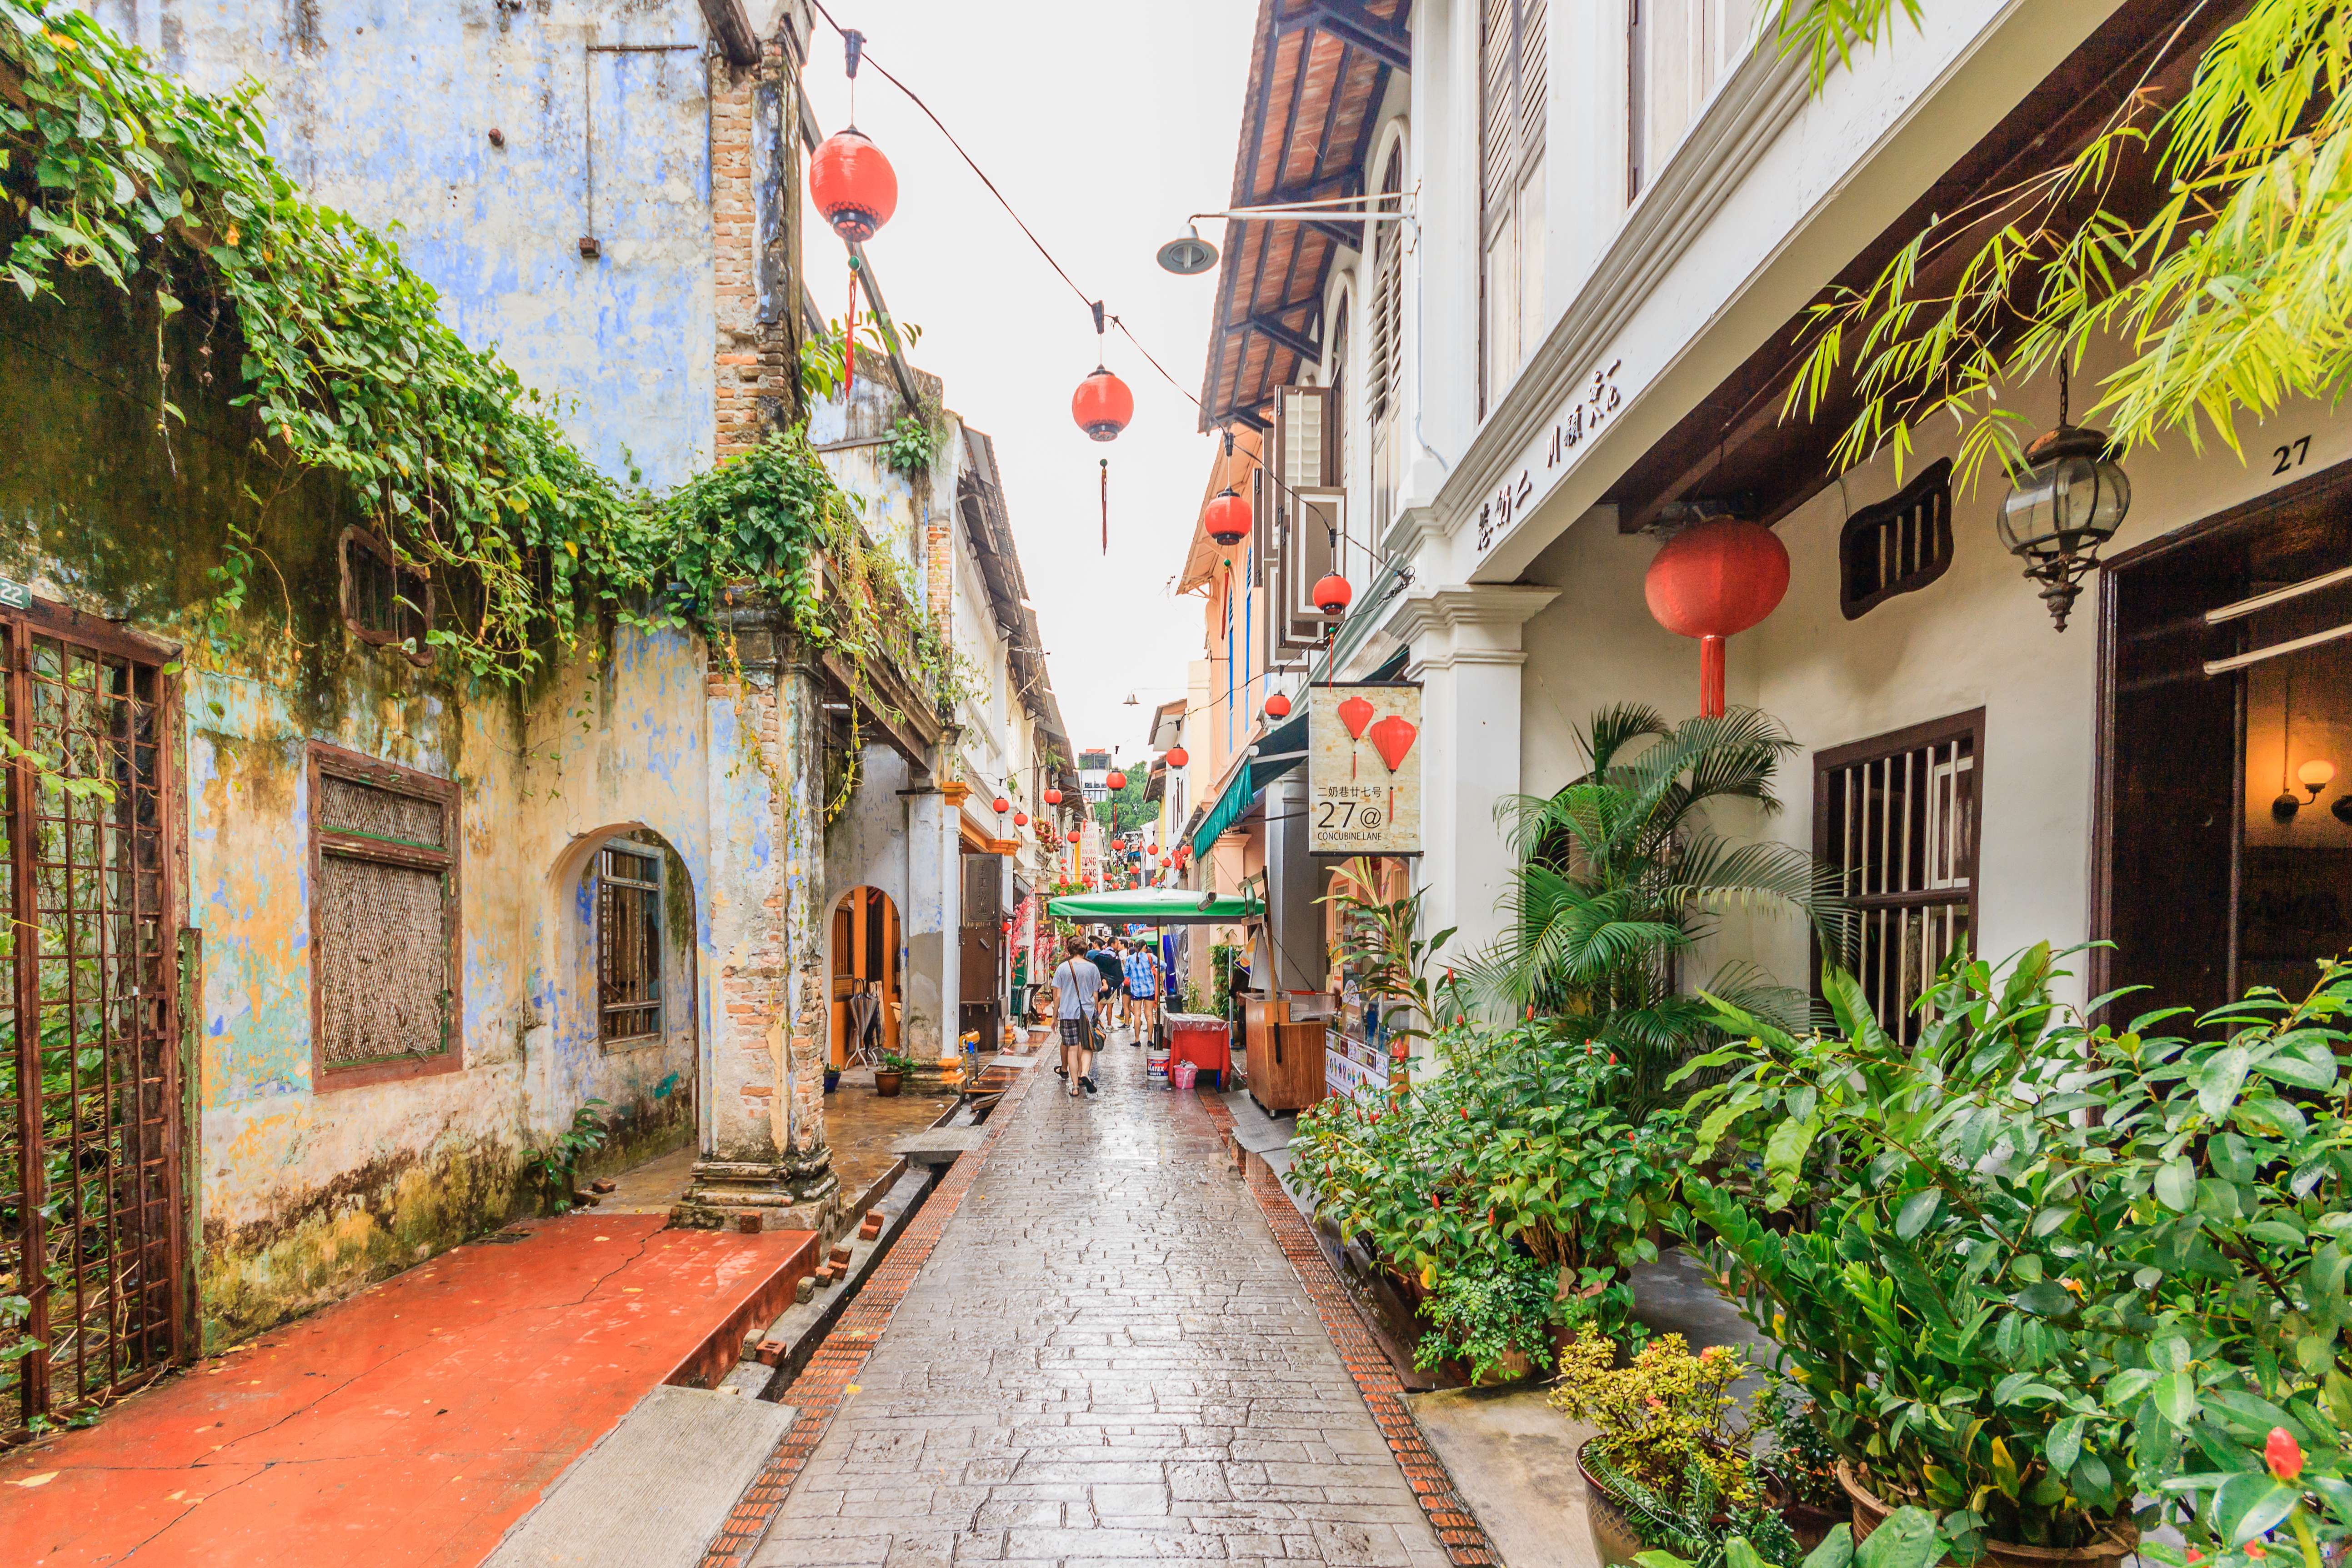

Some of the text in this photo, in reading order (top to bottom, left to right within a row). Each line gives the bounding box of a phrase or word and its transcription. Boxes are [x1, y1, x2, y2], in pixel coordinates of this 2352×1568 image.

[2272, 434, 2312, 476] 27
[1, 582, 22, 604] 22
[1317, 786, 1382, 797] 二奶巷廿七号
[1317, 832, 1381, 841] CONCUBINE LANE
[1082, 857, 1096, 866] DING
[1082, 869, 1096, 878] FENG
